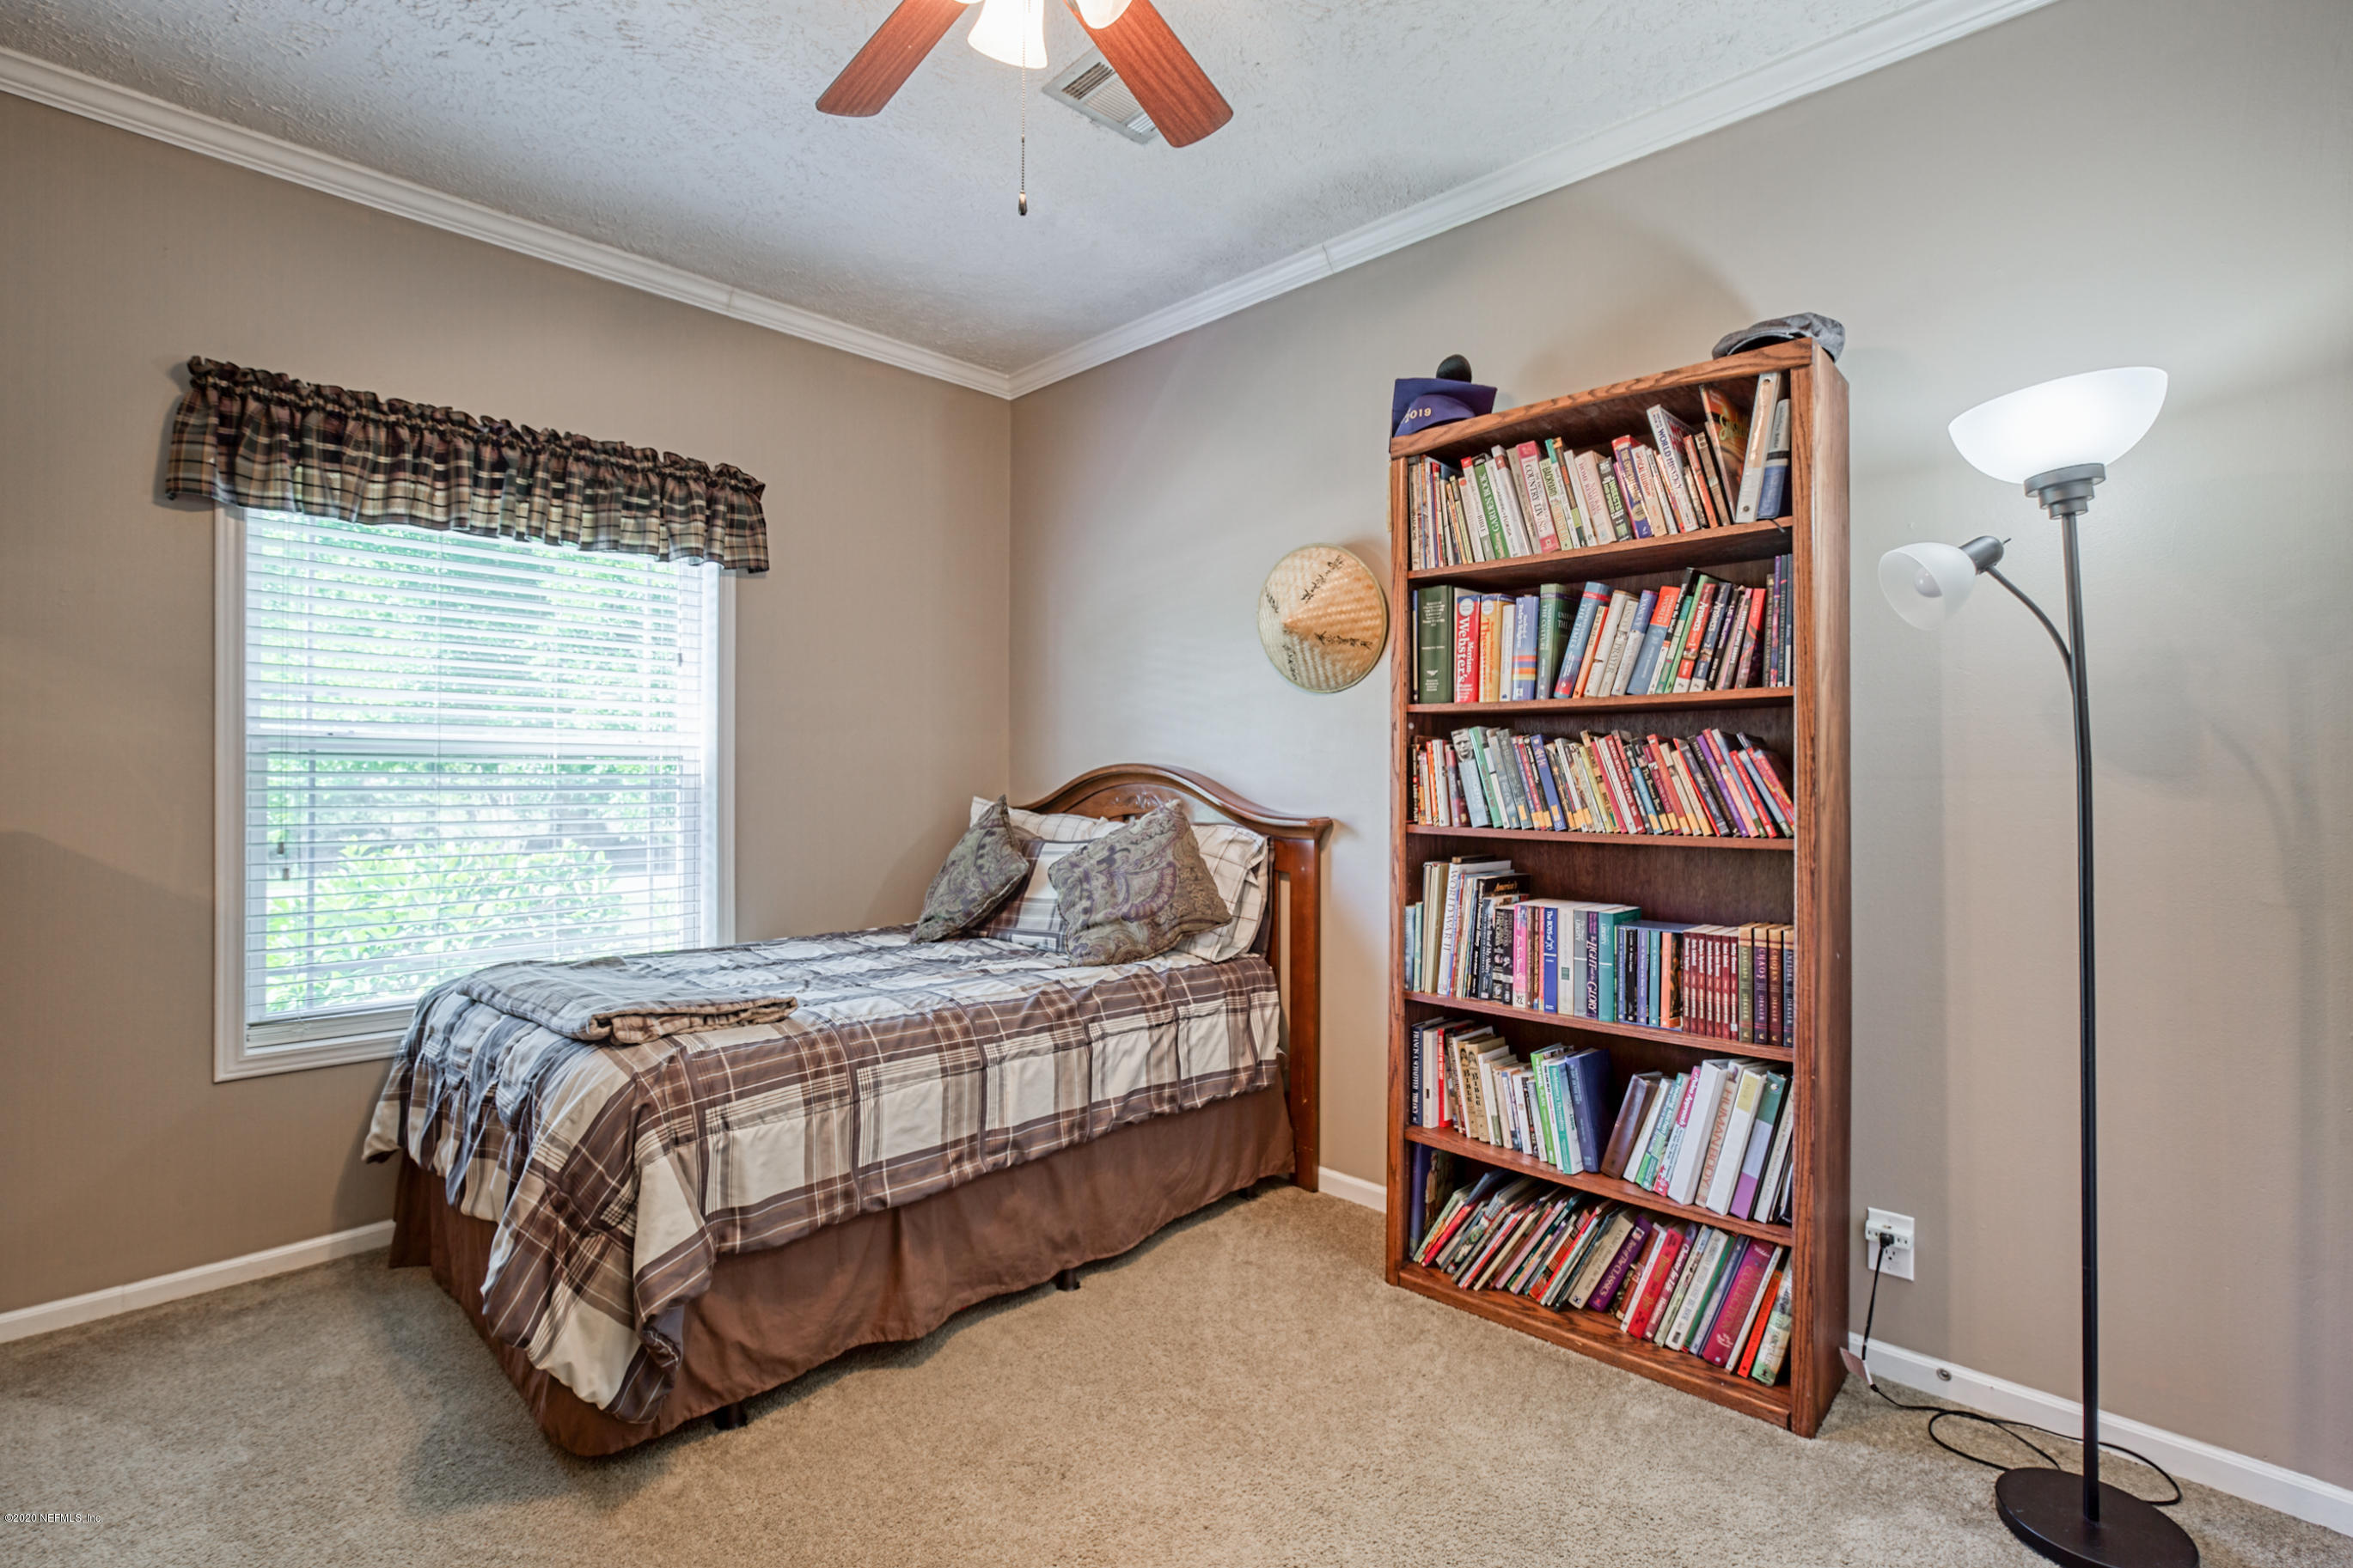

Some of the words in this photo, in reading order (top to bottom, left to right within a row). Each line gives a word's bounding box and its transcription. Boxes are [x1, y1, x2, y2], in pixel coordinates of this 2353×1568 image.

[1404, 408, 1432, 423] 2019
[1656, 428, 1672, 457] WORLD
[1524, 464, 1539, 502] COUNTRY
[1576, 602, 1586, 622] THE
[1457, 616, 1470, 681] Webster's
[1569, 622, 1581, 649] TIMES
[1606, 642, 1622, 674] PRAYER
[1446, 869, 1458, 913] WORLD
[1444, 914, 1453, 940] WAR
[1586, 941, 1596, 968] LIGHT
[1586, 981, 1597, 1012] GLORY
[1678, 1094, 1693, 1125] Approach
[1713, 1089, 1733, 1144] HUMAN
[1598, 1263, 1622, 1296] CLASSICS
[1720, 1264, 1754, 1331] COLLECTION
